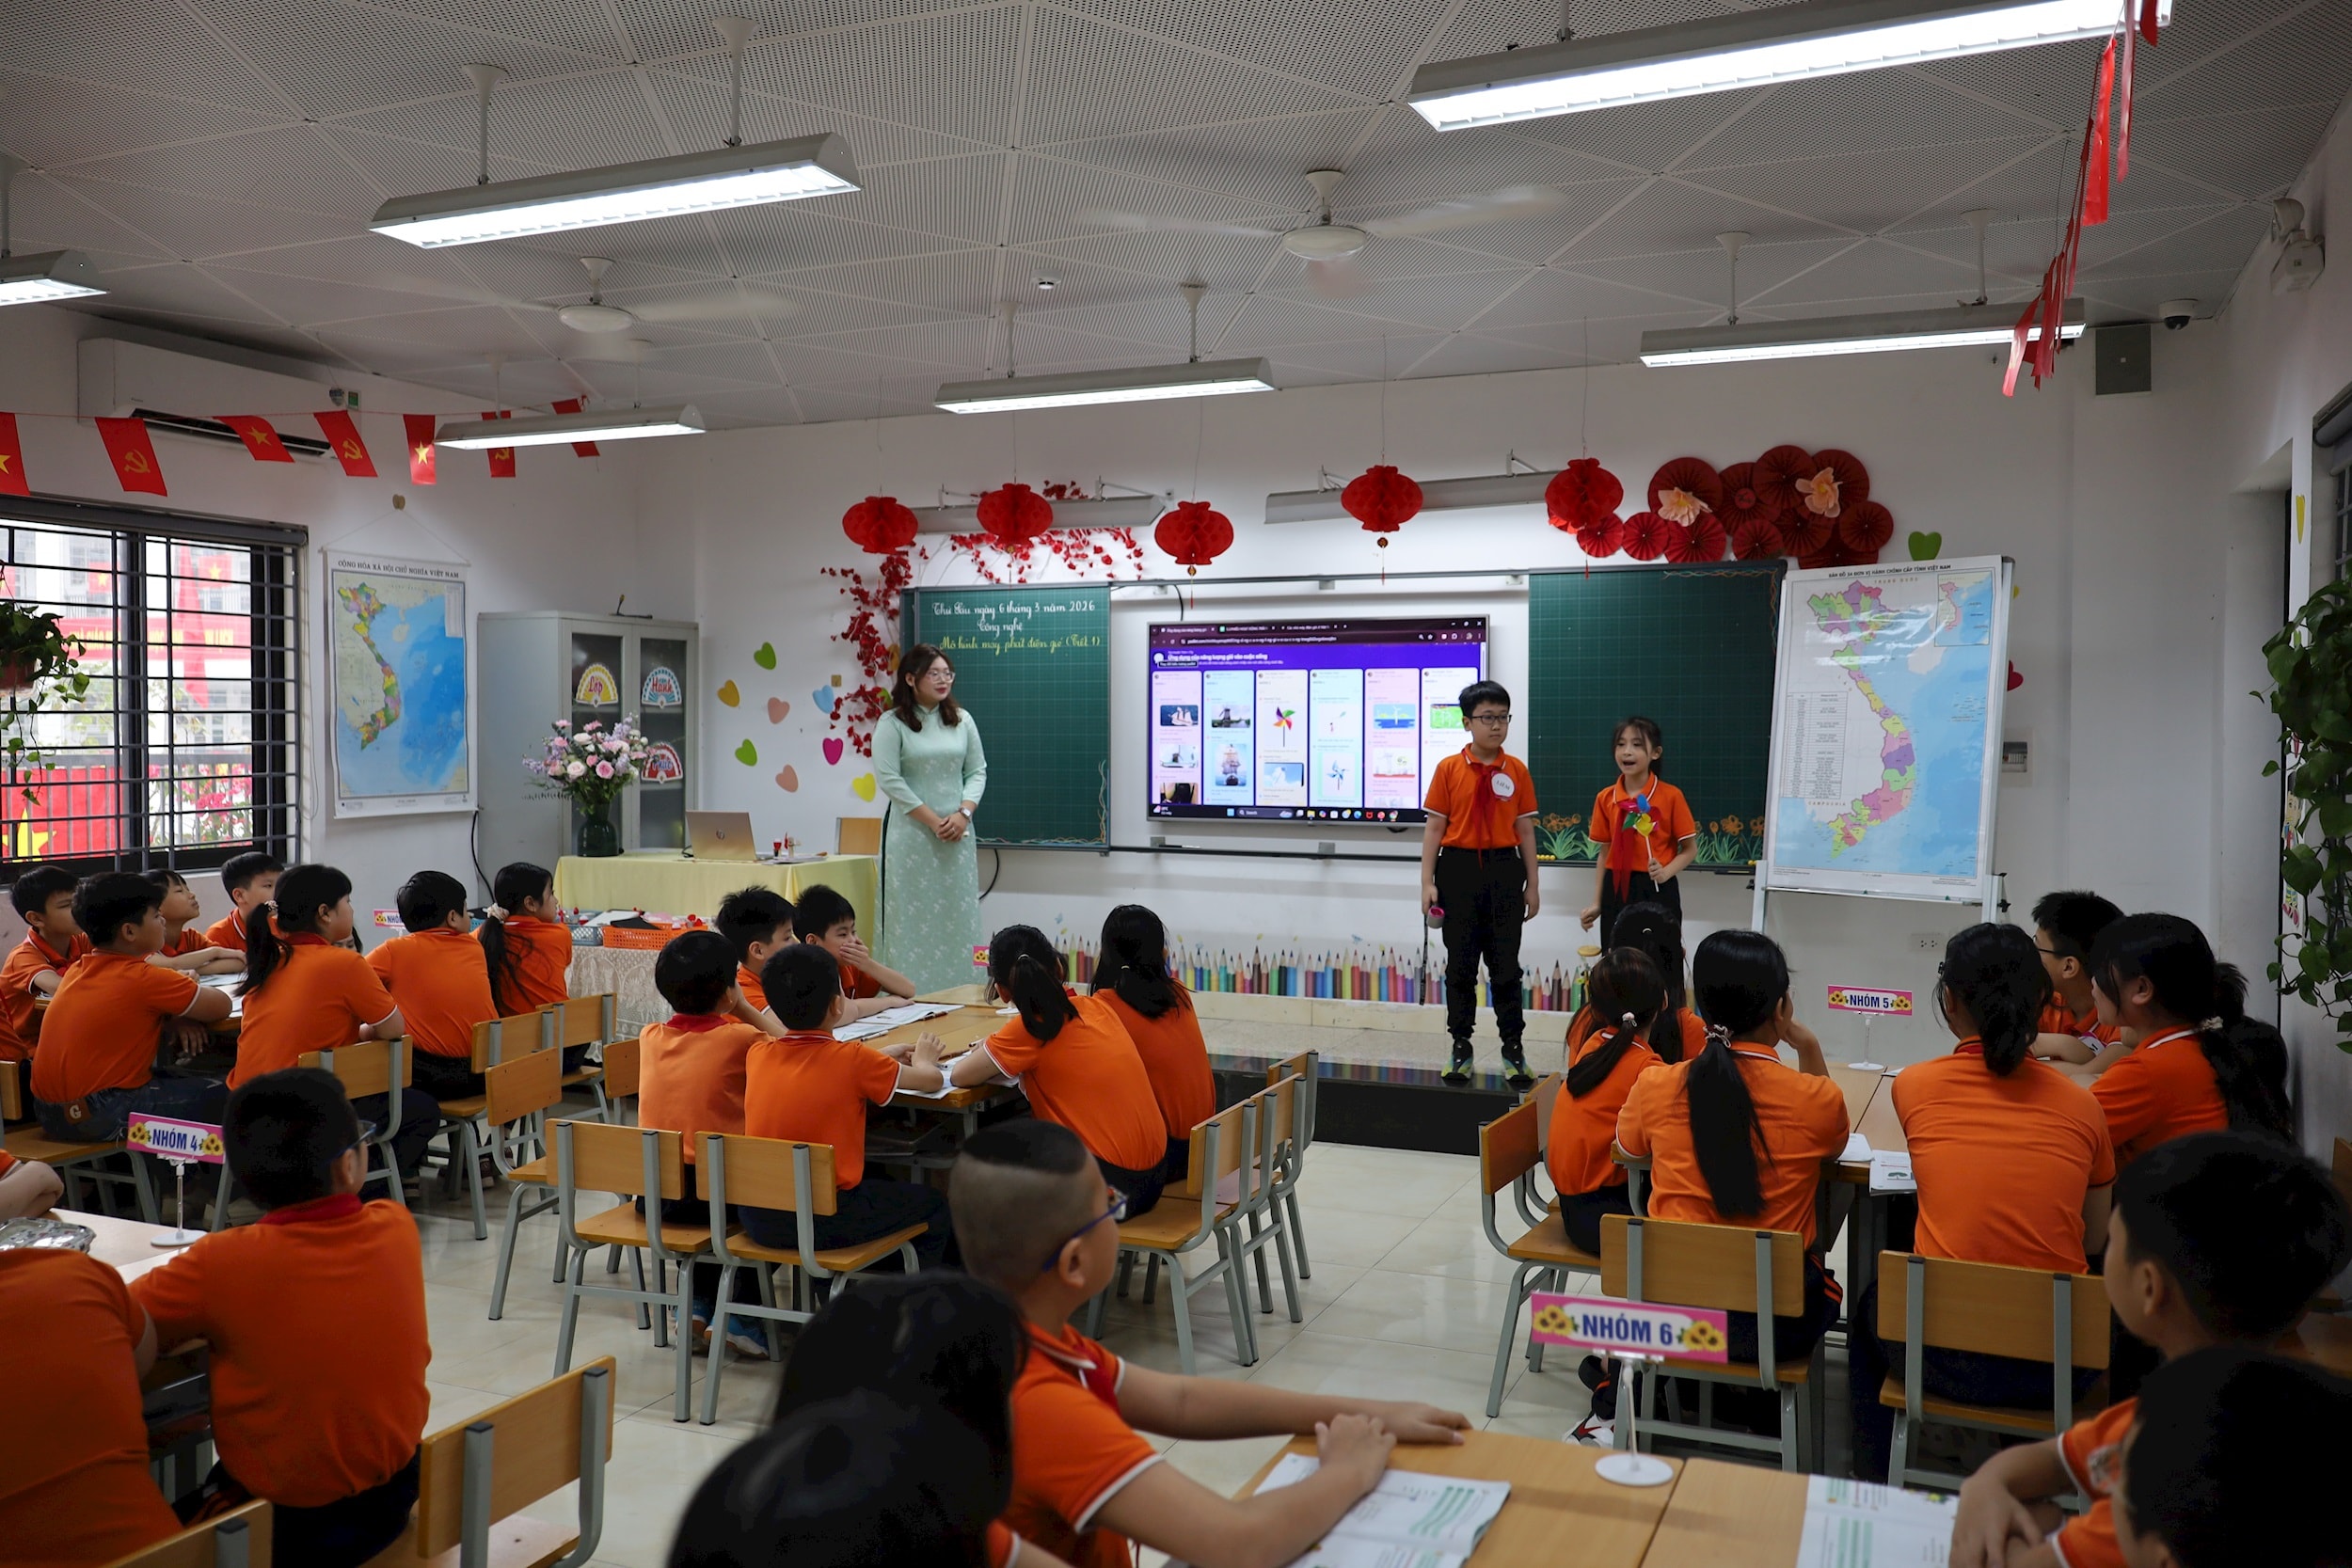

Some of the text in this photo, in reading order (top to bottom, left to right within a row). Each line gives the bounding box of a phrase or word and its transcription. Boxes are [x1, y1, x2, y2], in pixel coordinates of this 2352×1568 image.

[339, 560, 357, 568] CỘNG
[383, 563, 394, 573] HỘI
[430, 569, 443, 578] VIỆT
[974, 605, 995, 621] ngày
[999, 603, 1005, 613] 6
[1006, 600, 1032, 620] tháng
[1035, 602, 1040, 612] 3
[1069, 600, 1095, 612] 2026
[977, 618, 1000, 640] Công
[1091, 636, 1100, 646] 1)
[1850, 993, 1889, 1008] NHÓM 5
[69, 1104, 82, 1119] G
[152, 1128, 198, 1152] NHÓM 4
[1582, 1312, 1674, 1345] NHÓM 6
